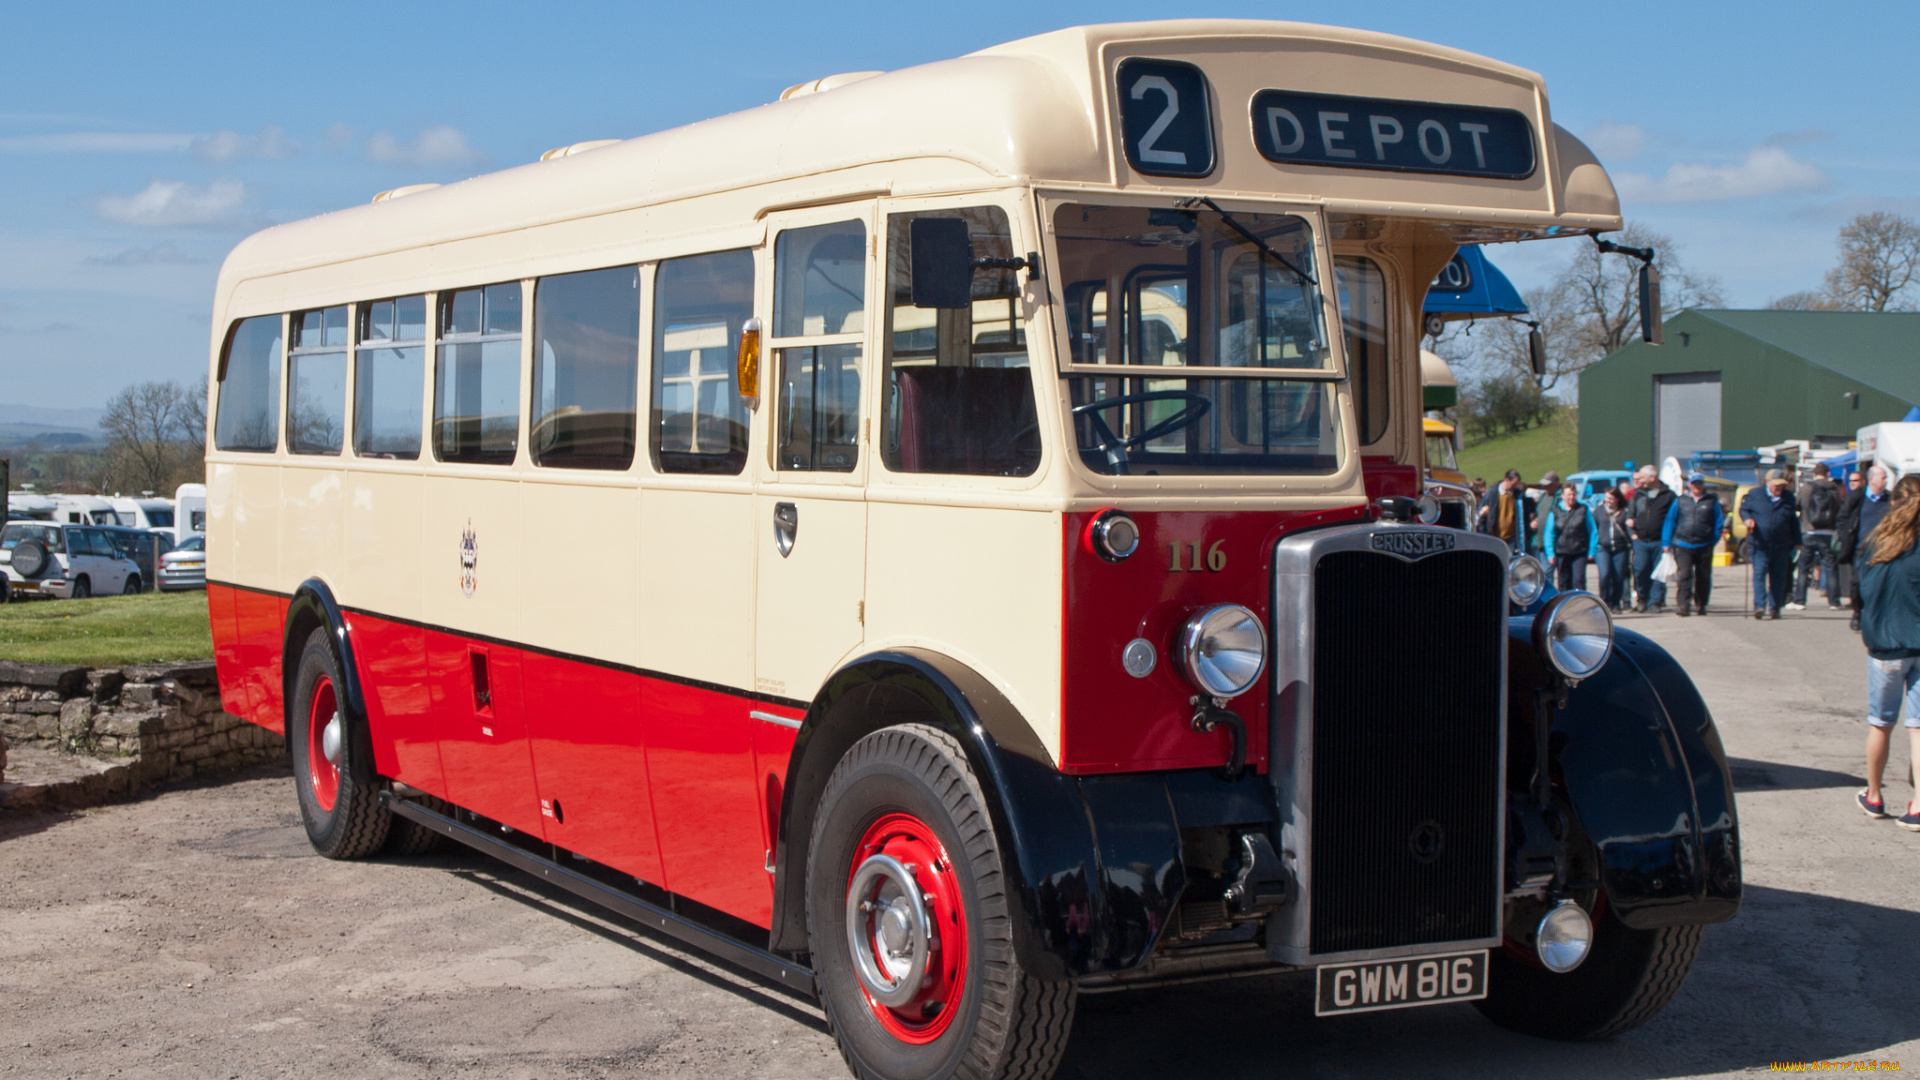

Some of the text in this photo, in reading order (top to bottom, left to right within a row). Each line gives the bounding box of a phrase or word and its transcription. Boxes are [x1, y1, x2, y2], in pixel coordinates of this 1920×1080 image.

[1131, 75, 1187, 165] 2
[1268, 107, 1489, 168] DEPOT
[1166, 538, 1227, 573] 116
[1373, 533, 1452, 554] CROSSLEY
[1335, 957, 1473, 1007] GWM 816
